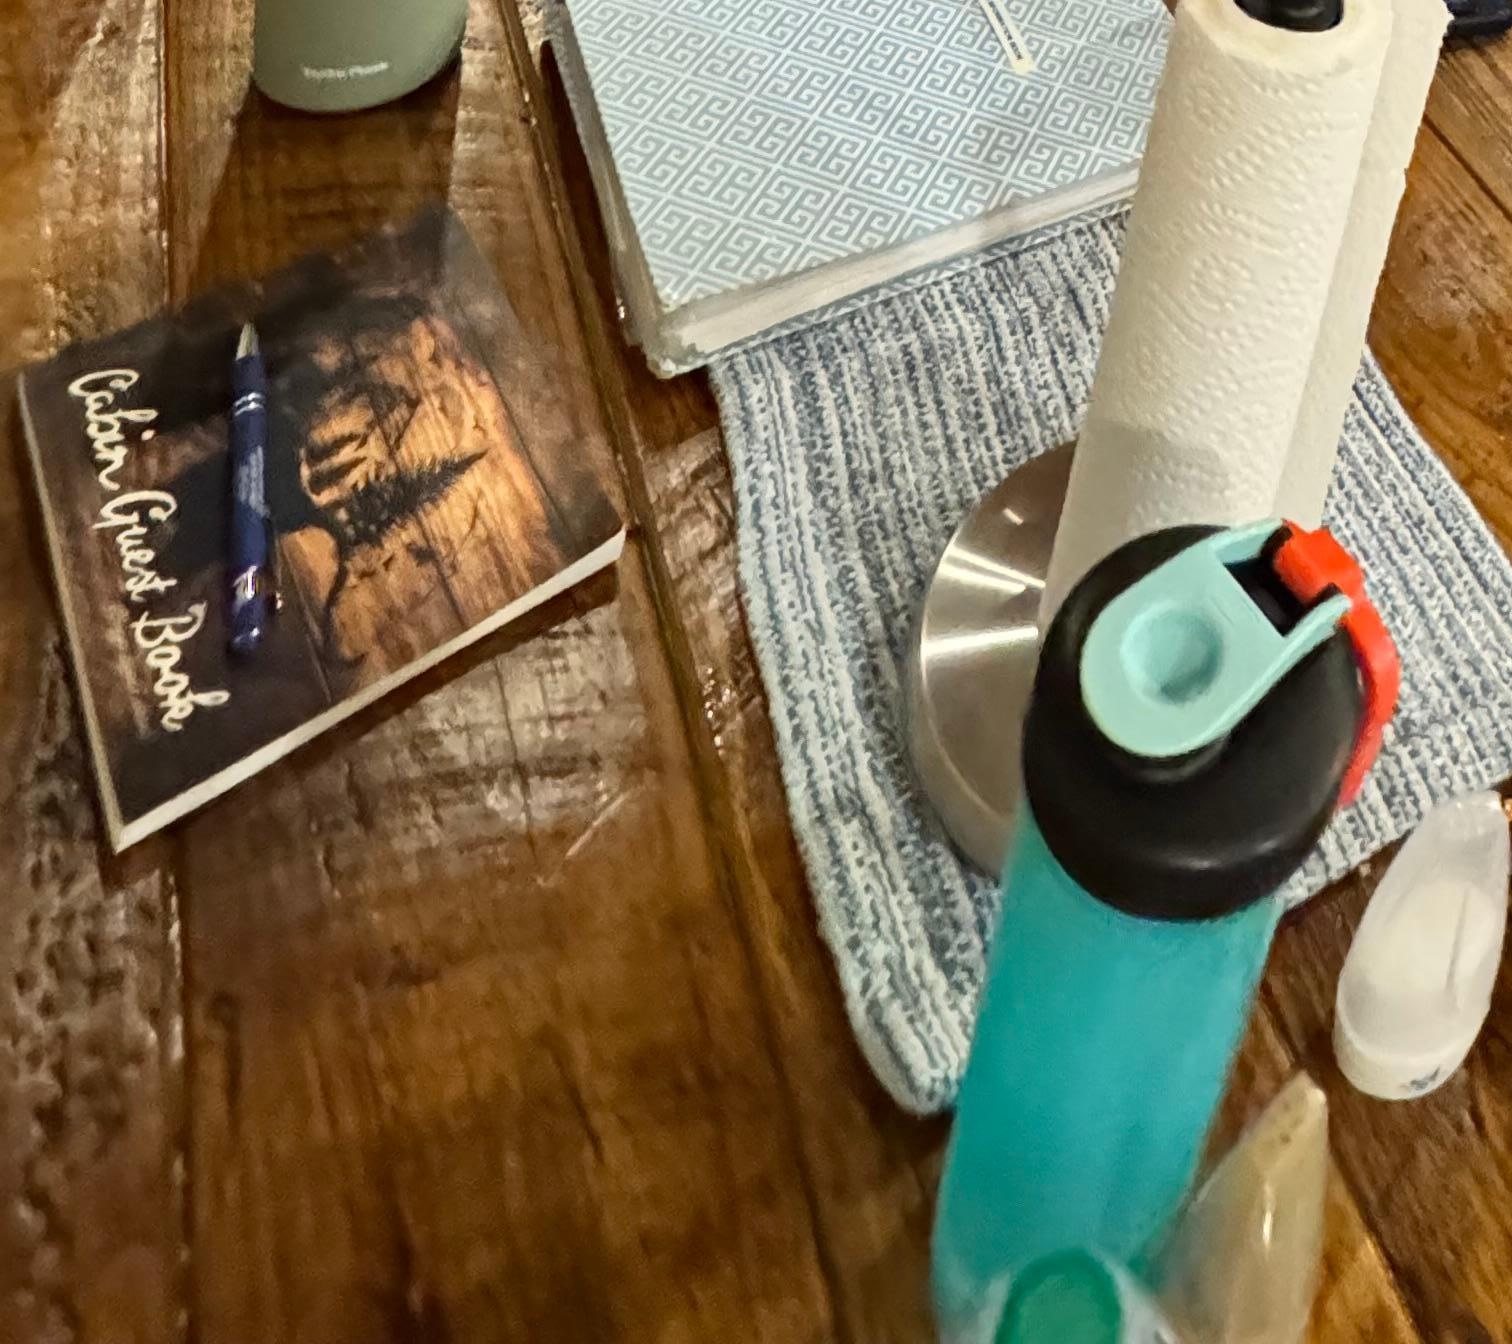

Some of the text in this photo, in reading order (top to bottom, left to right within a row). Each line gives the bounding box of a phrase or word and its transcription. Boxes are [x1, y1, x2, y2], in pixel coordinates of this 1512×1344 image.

[68, 367, 231, 732] Cabin Guest Book
